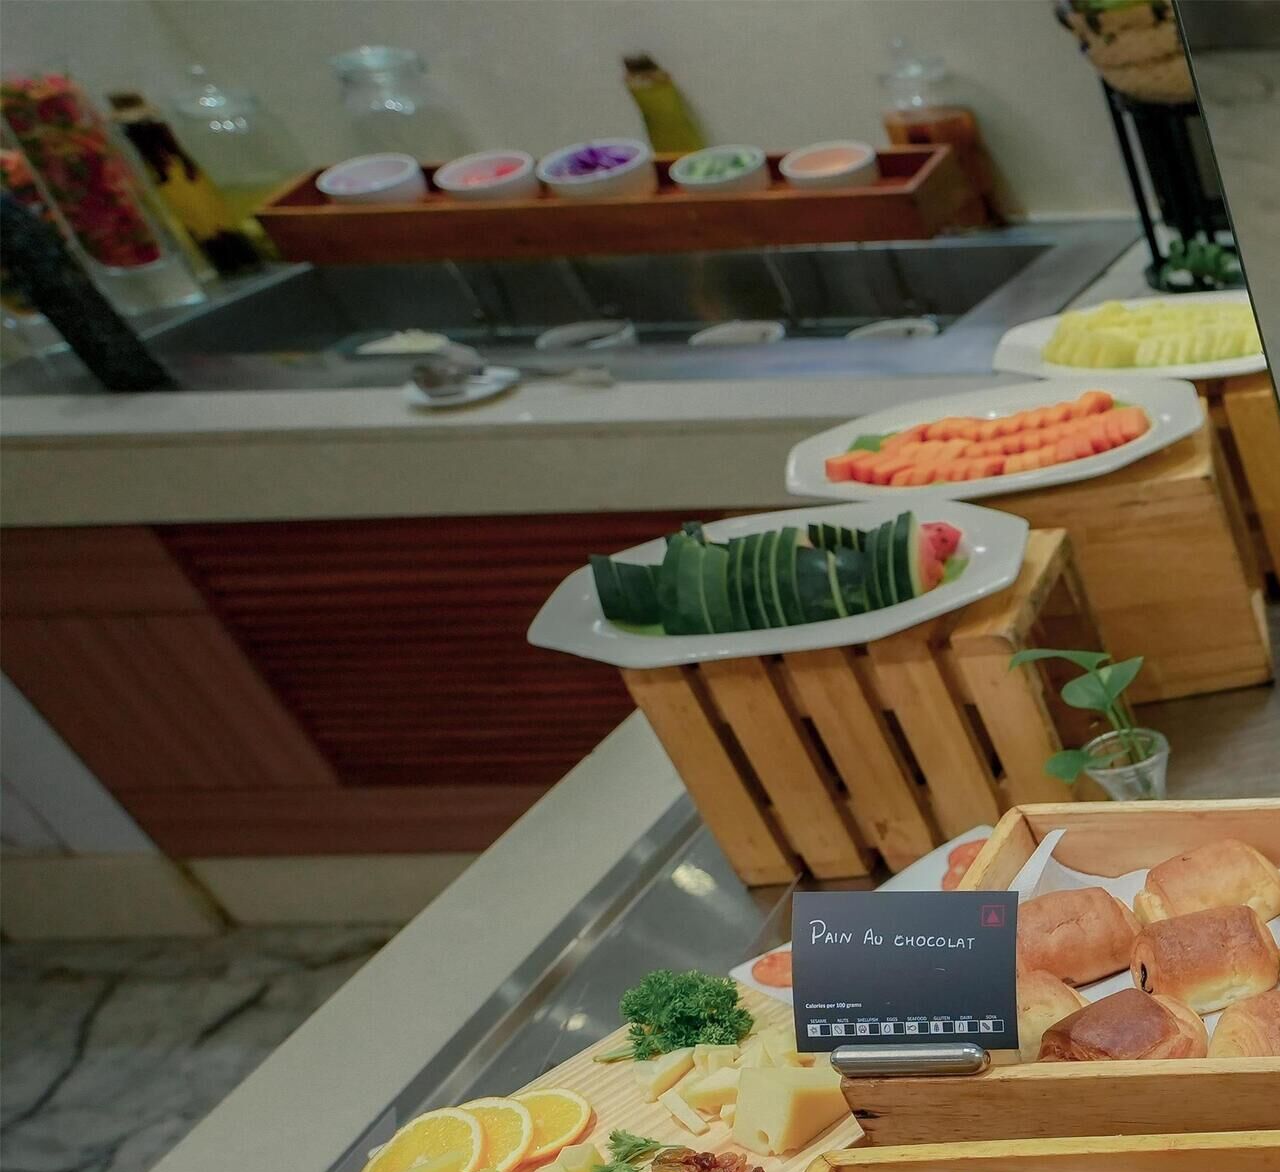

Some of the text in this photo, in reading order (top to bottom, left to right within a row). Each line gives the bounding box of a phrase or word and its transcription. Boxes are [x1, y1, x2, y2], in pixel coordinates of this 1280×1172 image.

[809, 920, 976, 950] PAIN AU CHOCOLAT
